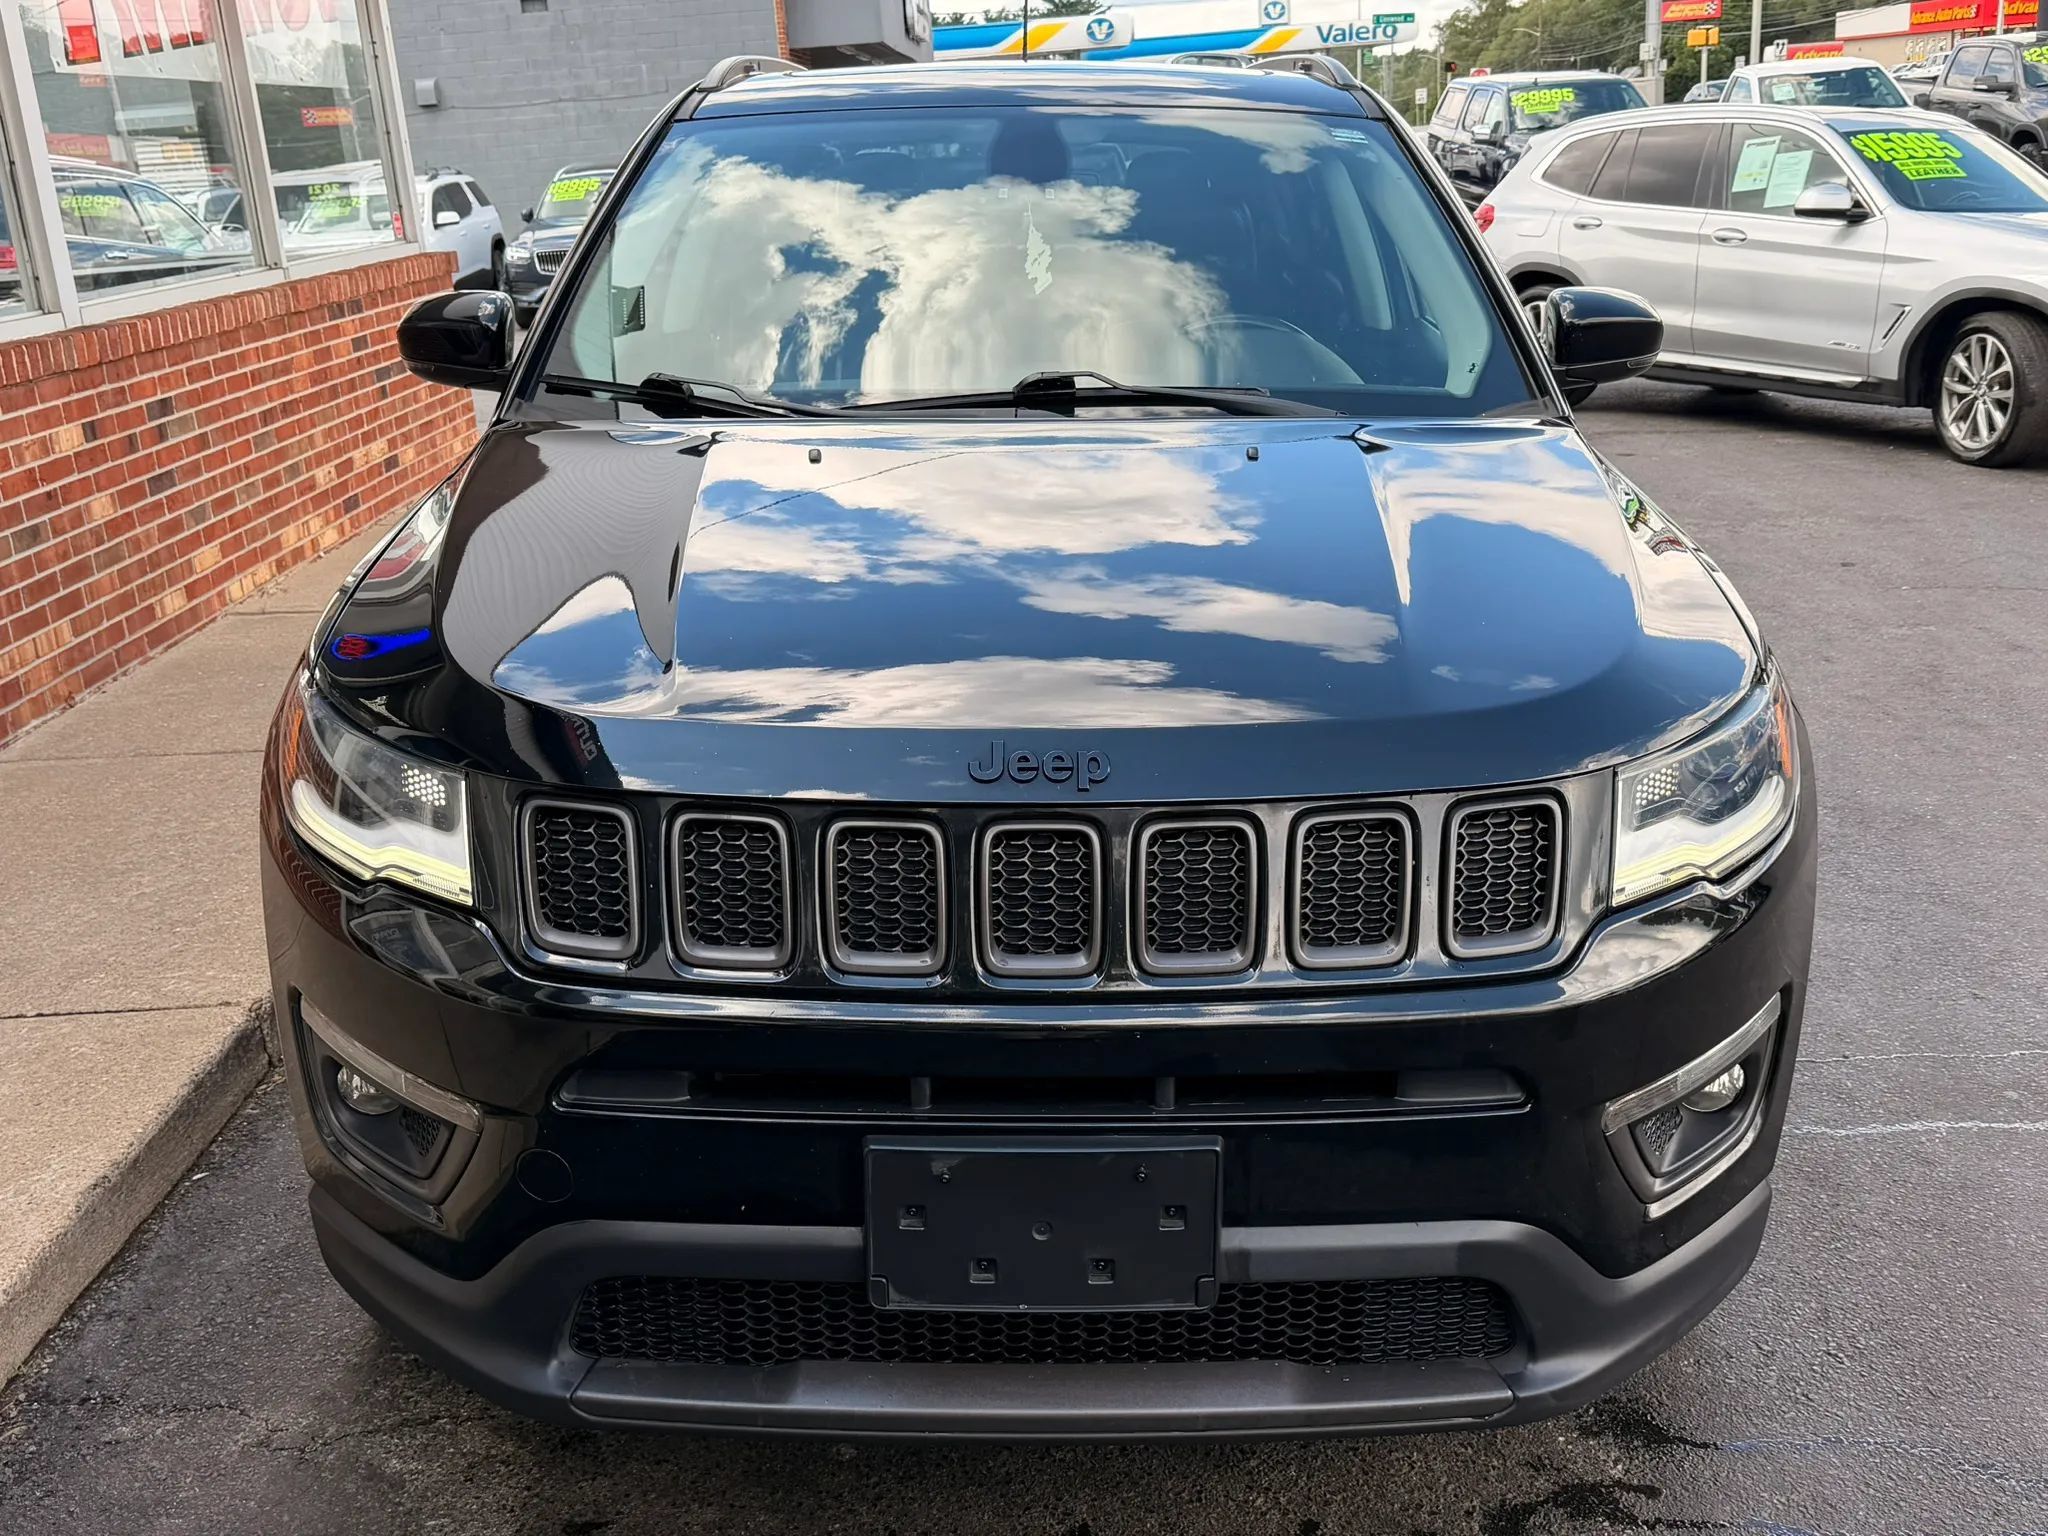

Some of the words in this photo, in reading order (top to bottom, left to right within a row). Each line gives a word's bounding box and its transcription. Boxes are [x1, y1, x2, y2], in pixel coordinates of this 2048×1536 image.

[1316, 23, 1398, 44] Valero
[1511, 88, 1575, 106] $29995
[1850, 132, 1964, 162] $15995
[1908, 167, 1960, 178] LEATHER
[968, 740, 1111, 792] Jeep
